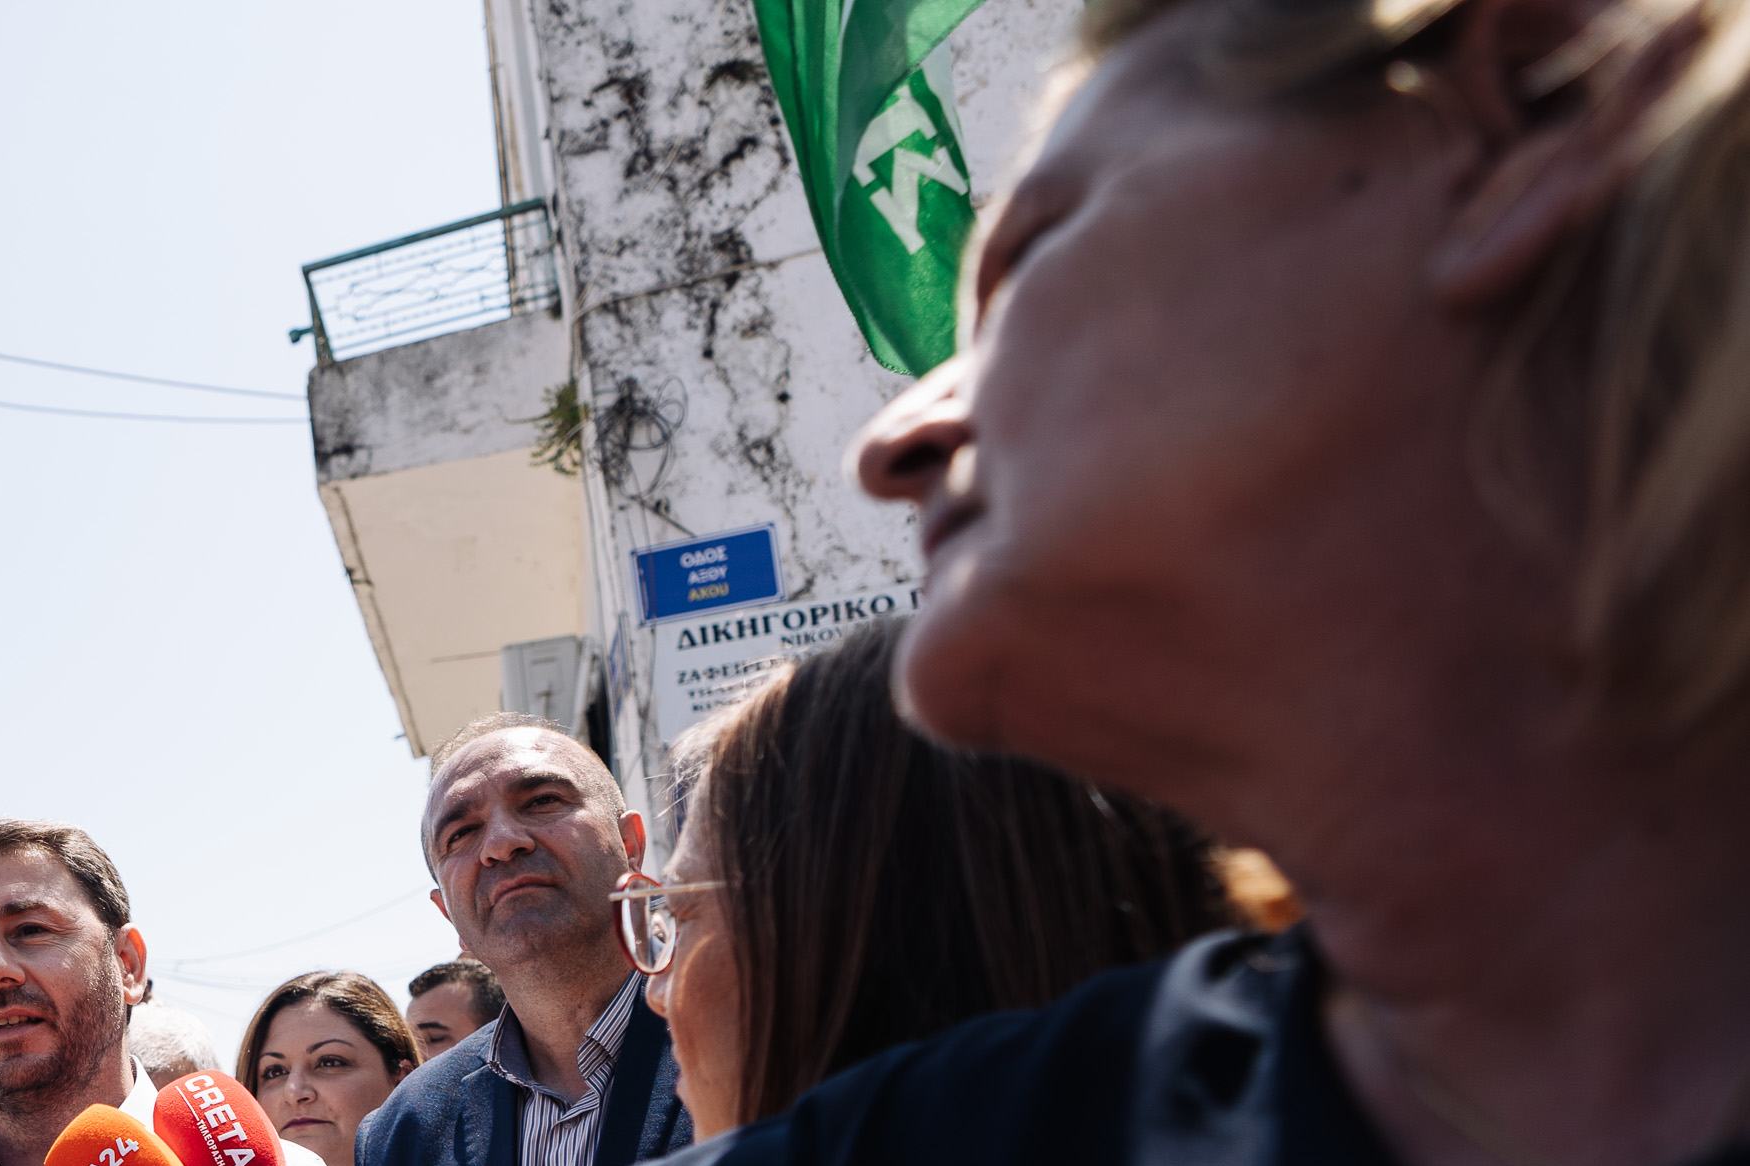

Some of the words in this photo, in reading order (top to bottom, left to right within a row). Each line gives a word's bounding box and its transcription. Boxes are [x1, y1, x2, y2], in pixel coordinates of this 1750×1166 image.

[680, 544, 728, 569] ΟΔΟΣ
[688, 563, 728, 585] ΑΞΟΥ
[677, 594, 895, 650] ΔΙΚΗΓΟΡΙΚΟ
[196, 1119, 226, 1166] ΤΗΛΕΟΡΑΣΗ
